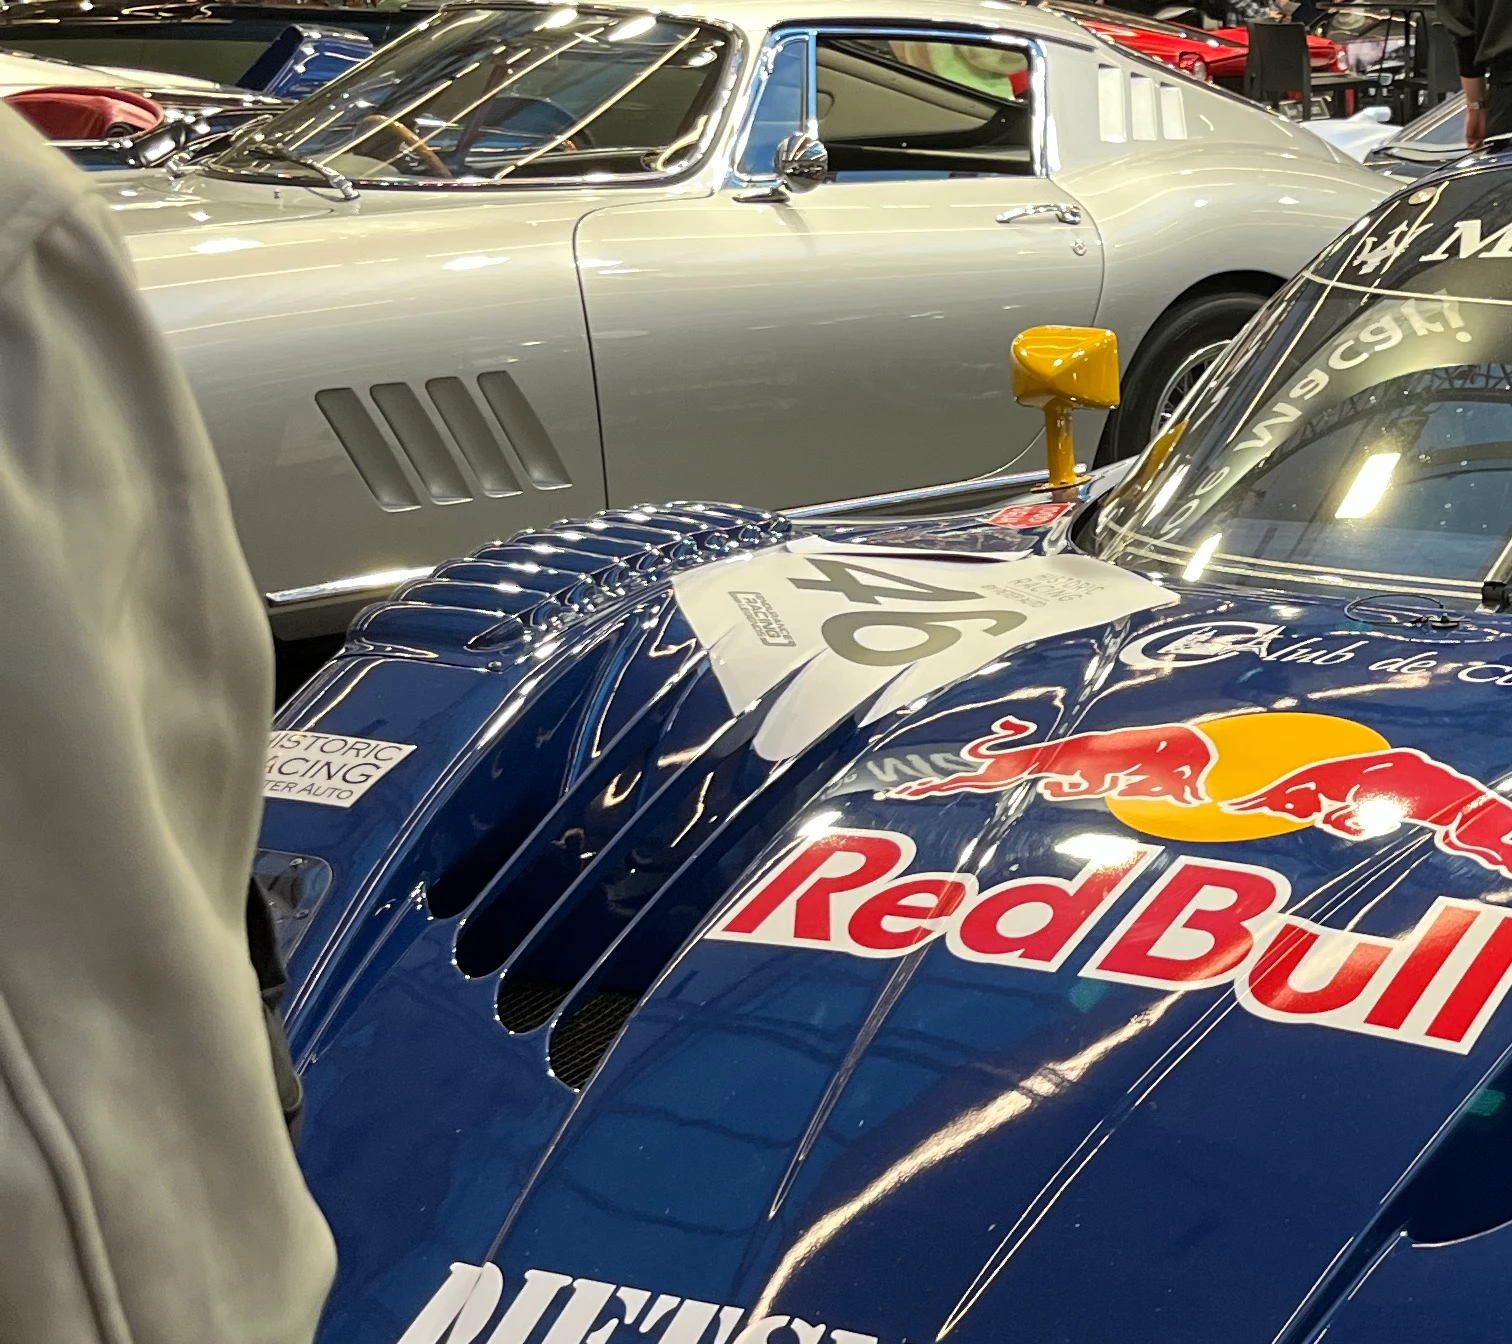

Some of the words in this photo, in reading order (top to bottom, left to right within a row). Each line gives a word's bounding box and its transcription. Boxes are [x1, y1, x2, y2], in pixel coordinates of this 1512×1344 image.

[1369, 651, 1437, 675] de
[265, 755, 382, 784] ACING
[263, 779, 297, 793] TER
[301, 782, 354, 800] AUTO
[712, 833, 1156, 970] Red
